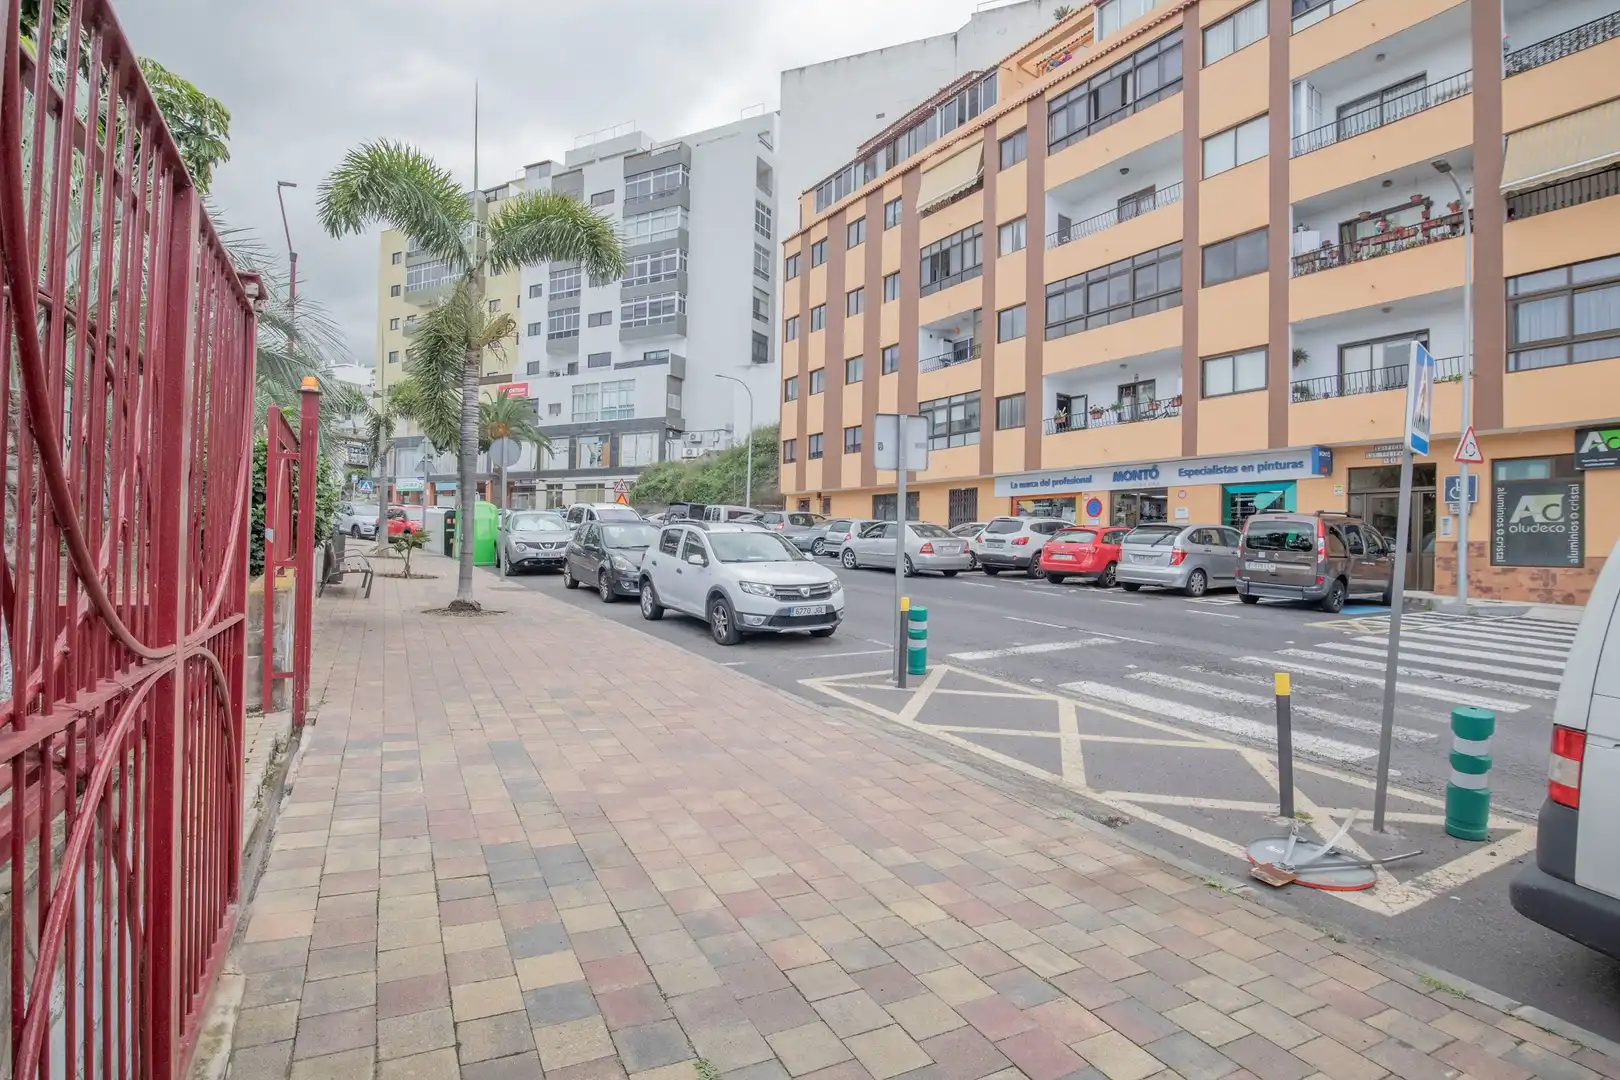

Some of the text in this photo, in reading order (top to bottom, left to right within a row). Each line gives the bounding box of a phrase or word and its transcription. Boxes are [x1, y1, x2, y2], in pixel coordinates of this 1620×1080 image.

[1178, 464, 1239, 479] Especialistas
[1241, 464, 1254, 472] en
[1257, 460, 1304, 474] pinturas
[1010, 475, 1093, 490] La marca del profesional
[1496, 487, 1507, 563] aluminios cristal
[1567, 483, 1580, 564] aluminios cristal
[795, 607, 811, 616] 6770
